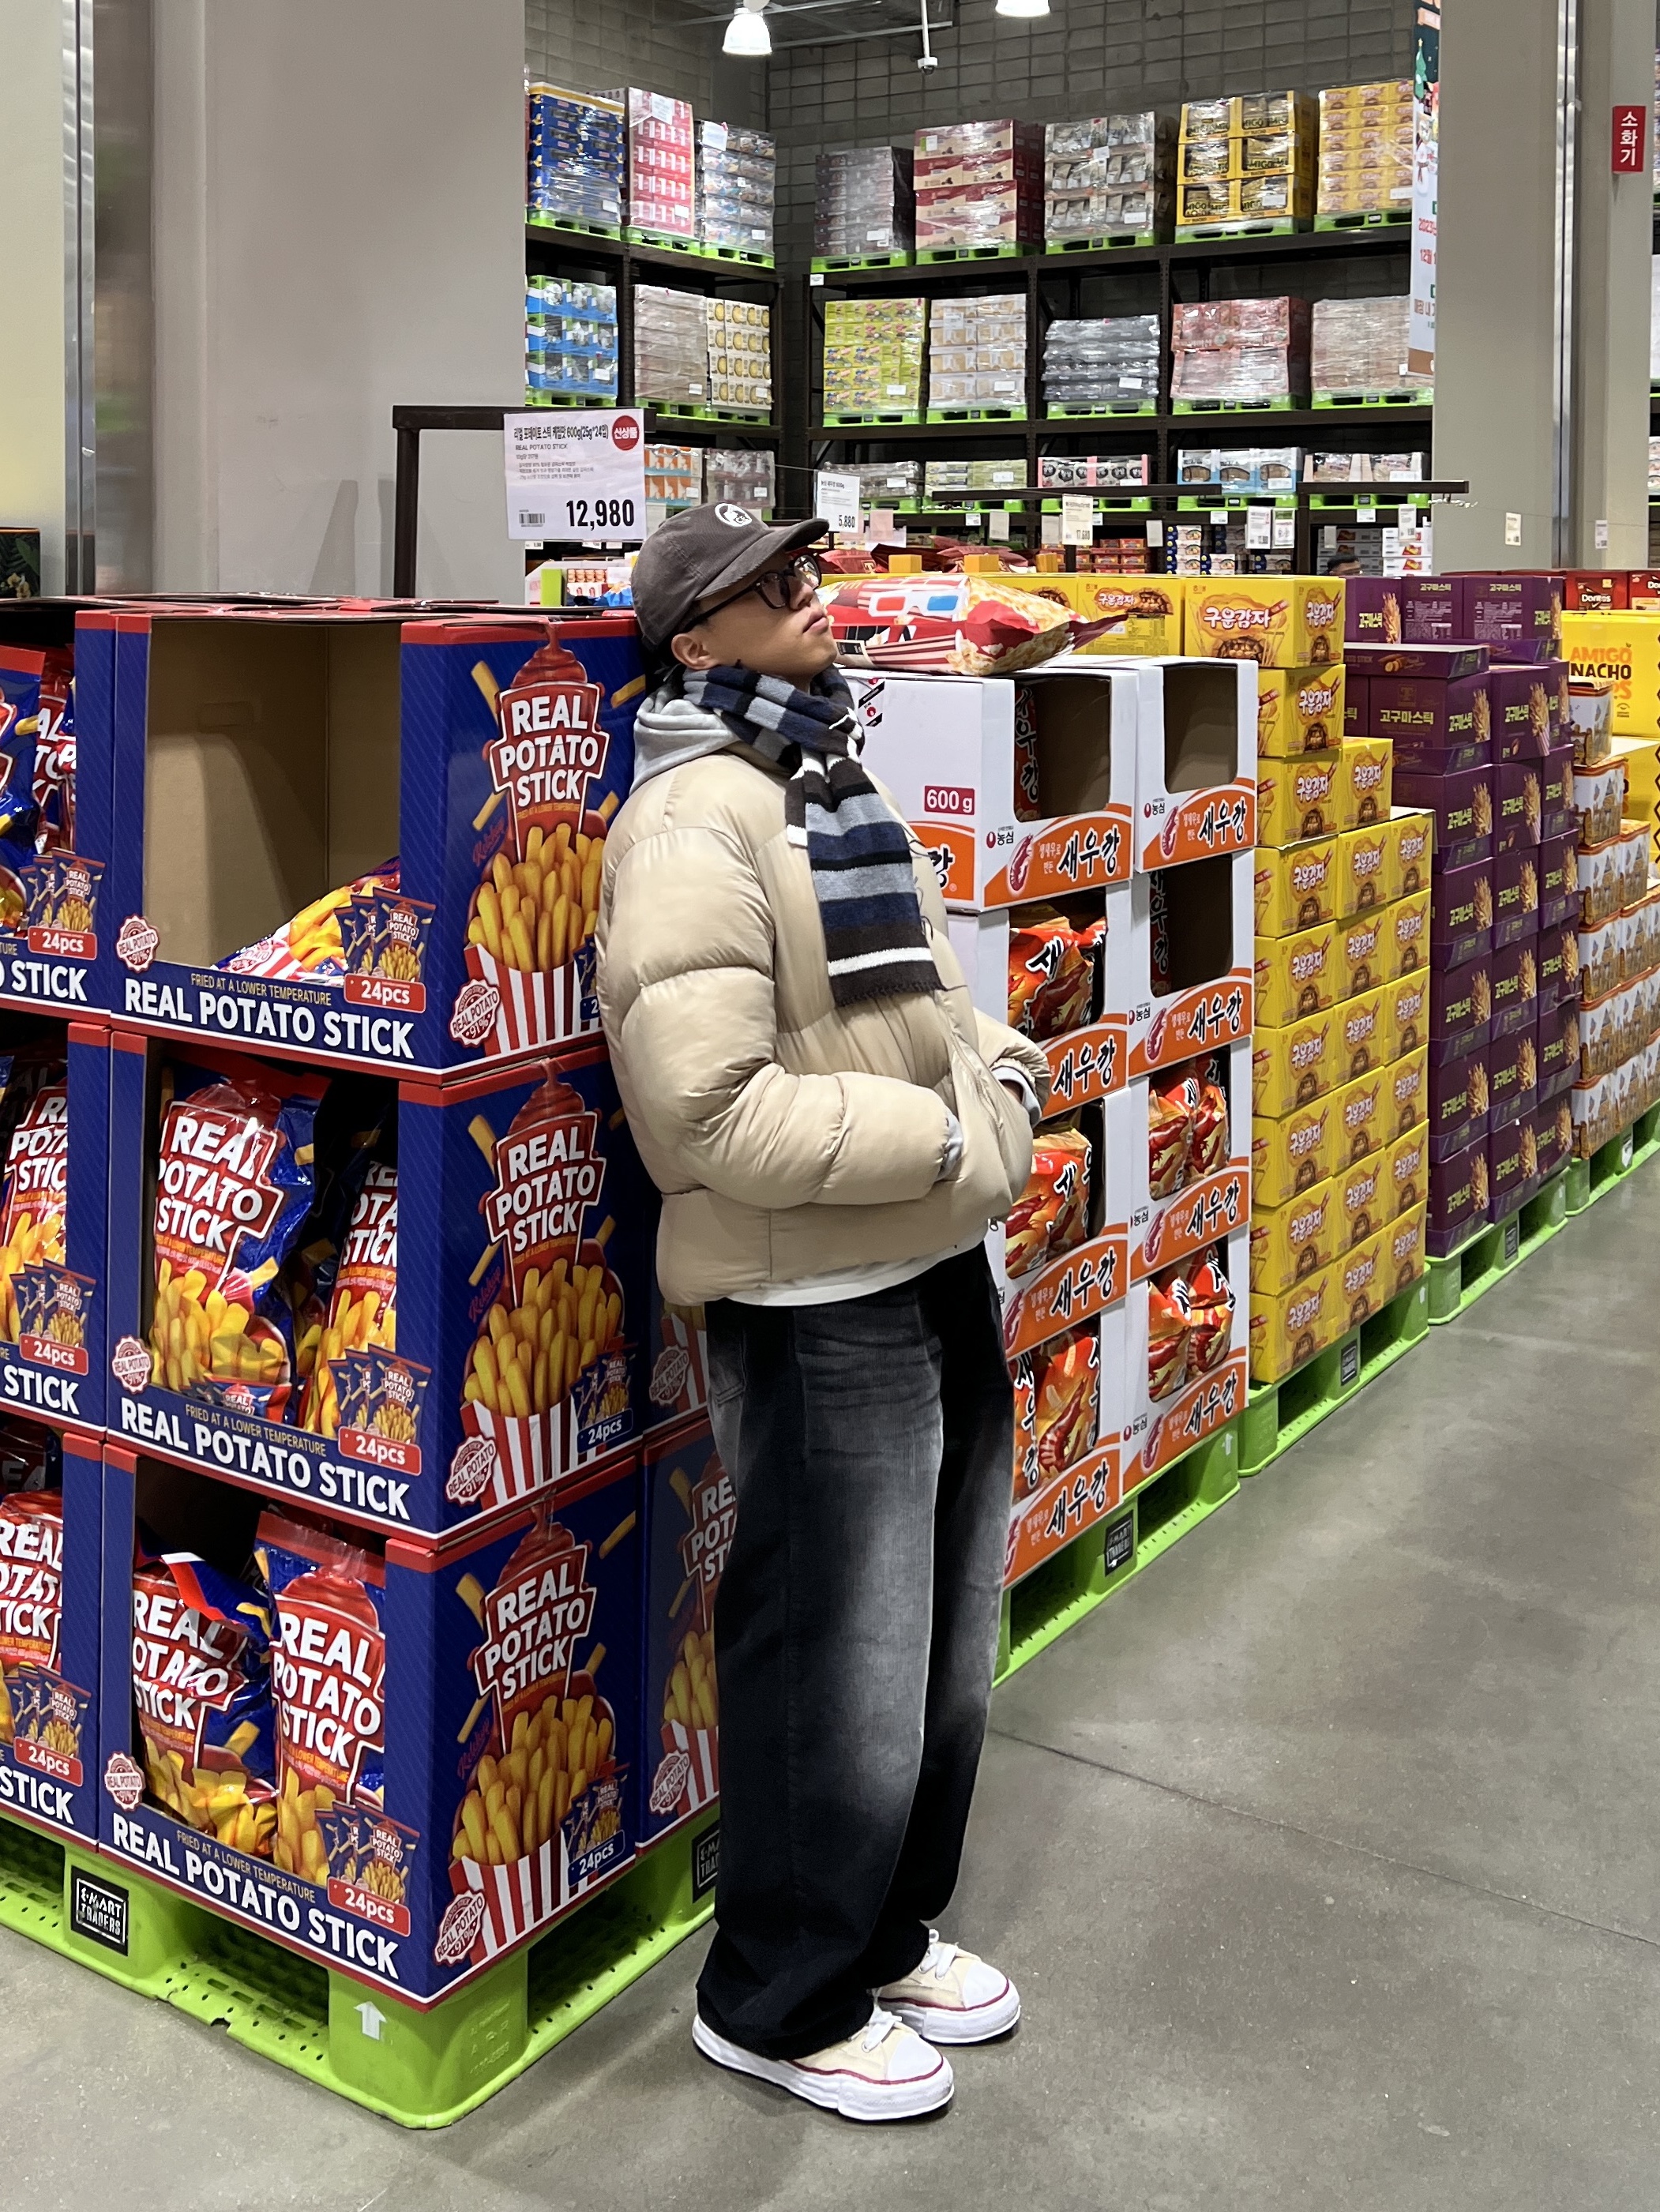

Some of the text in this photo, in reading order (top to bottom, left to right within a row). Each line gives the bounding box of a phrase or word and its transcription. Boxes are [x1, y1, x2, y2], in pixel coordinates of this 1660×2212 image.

[1620, 111, 1639, 167] 소화기
[614, 426, 638, 440] 신상품
[566, 499, 634, 531] 12,980
[1306, 599, 1335, 628] 구운감자
[1581, 594, 1612, 603] Doritos
[1204, 606, 1271, 629] 구운감자
[1570, 647, 1632, 664] AMIGO
[1571, 663, 1632, 680] NACHO
[511, 695, 588, 736] REAL
[1298, 689, 1332, 716] 구운감자
[1380, 710, 1434, 725] 고구마스틱
[500, 734, 599, 779] POTATO
[517, 769, 584, 807] STICK
[1296, 774, 1329, 802] 구운감자
[1353, 764, 1381, 791] 구운감자
[927, 790, 972, 813] 600 g
[1152, 802, 1166, 815] 농심
[997, 831, 1014, 845] 농심
[1199, 796, 1246, 847] 새우깡
[1058, 826, 1120, 880] 새우깡
[66, 879, 88, 891] POTATO
[69, 871, 86, 882] REAL
[69, 887, 85, 896] STICK
[389, 922, 415, 936] POTATO
[392, 913, 414, 926] REAL
[42, 932, 84, 954] 24pcs
[392, 932, 412, 942] STICK
[11, 960, 87, 1001] STICK
[191, 973, 331, 1005] FRIED AT A LOWER TEMPERATURE
[361, 979, 410, 1005] 24pcs
[126, 978, 415, 1059] REAL POTATO STICK
[453, 991, 498, 1035] REAL POTATO
[1189, 990, 1243, 1042] 새우깡
[1053, 1036, 1117, 1098] 새우깡
[508, 1126, 584, 1182] REAL
[496, 1165, 595, 1227] POTATO
[1187, 1180, 1240, 1237] 새우깡
[158, 1196, 233, 1252] STICK
[513, 1201, 580, 1252] STICK
[1050, 1249, 1117, 1320] 새우깡
[33, 1343, 76, 1367] 24pcs
[5, 1365, 79, 1415] STICK
[385, 1379, 411, 1399] POTATO
[387, 1371, 410, 1386] REAL
[388, 1391, 406, 1403] STICK
[1185, 1369, 1237, 1436] 새우깡
[186, 1404, 326, 1457] FRIED AT A LOWER TEMPERATURE
[588, 1418, 622, 1444] 24pcs
[121, 1398, 411, 1520] REAL POTATO STICK
[356, 1435, 405, 1465] 24pcs
[449, 1444, 495, 1497] REAL POTATO
[1045, 1459, 1110, 1538] 새우깡
[497, 1562, 575, 1633] REAL
[134, 1590, 223, 1658] REAL
[485, 1597, 585, 1680] POTATO
[280, 1612, 372, 1688] REAL
[502, 1636, 570, 1700] STICK
[51, 1699, 75, 1715] POTATO
[54, 1691, 73, 1705] REAL
[274, 1654, 380, 1736] POTATO
[54, 1709, 70, 1720] STICK
[282, 1700, 355, 1768] STICK
[28, 1745, 70, 1775] 24pcs
[0, 1766, 74, 1826] STICK
[373, 1838, 400, 1858] POTATO
[375, 1829, 397, 1849] REAL
[377, 1847, 395, 1862] STICK
[177, 1830, 315, 1903] FRIED AT A LOWER TEMPERATURE
[579, 1842, 614, 1876] 24pcs
[113, 1813, 399, 1980] REAL POTATO STICK
[345, 1887, 395, 1924] 24pcs
[81, 1903, 121, 1936] TRADERS
[437, 1896, 483, 1958] REAL POTATO
